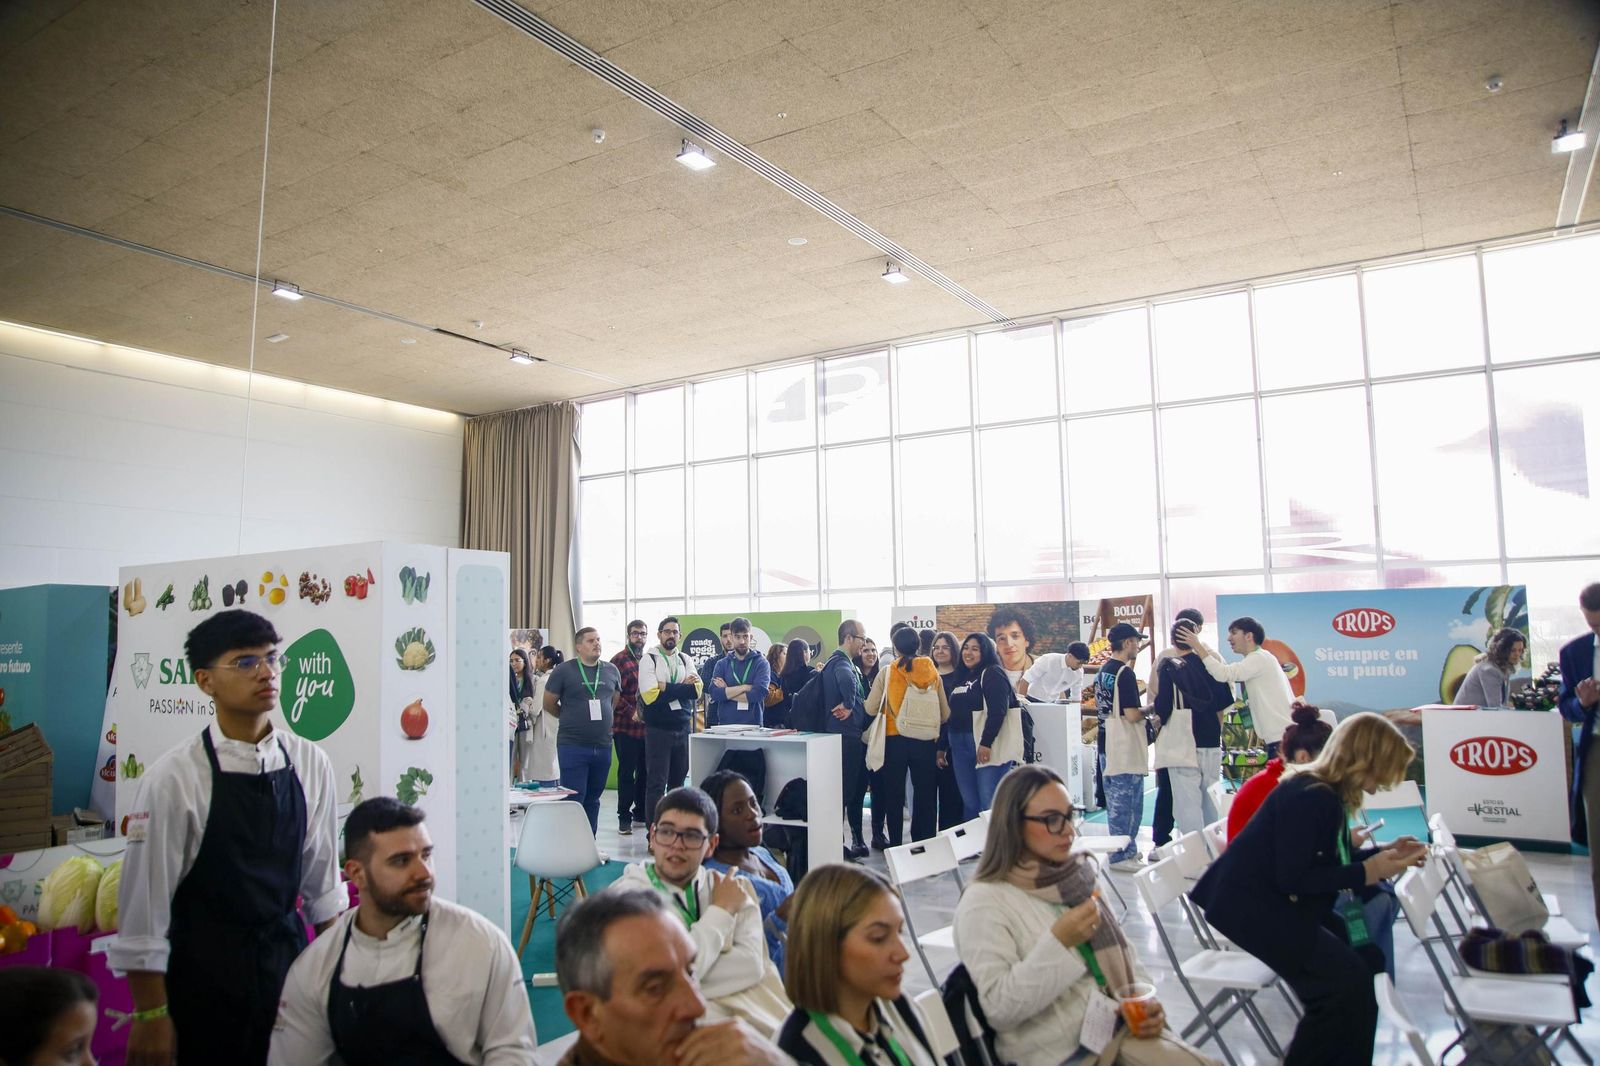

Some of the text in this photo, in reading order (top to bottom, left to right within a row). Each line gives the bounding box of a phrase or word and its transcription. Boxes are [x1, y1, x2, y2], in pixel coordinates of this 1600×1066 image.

[1113, 604, 1144, 617] BOLLO
[898, 620, 934, 628] OLLO
[1082, 615, 1096, 624] BO
[1335, 610, 1392, 632] TROPS
[299, 651, 332, 674] with
[1314, 647, 1418, 664] Siempre en
[8, 658, 31, 673] futuro
[159, 658, 196, 685] SA
[1327, 663, 1407, 680] su punto
[197, 701, 206, 715] in
[291, 676, 335, 723] you
[1454, 739, 1534, 769] TROPS
